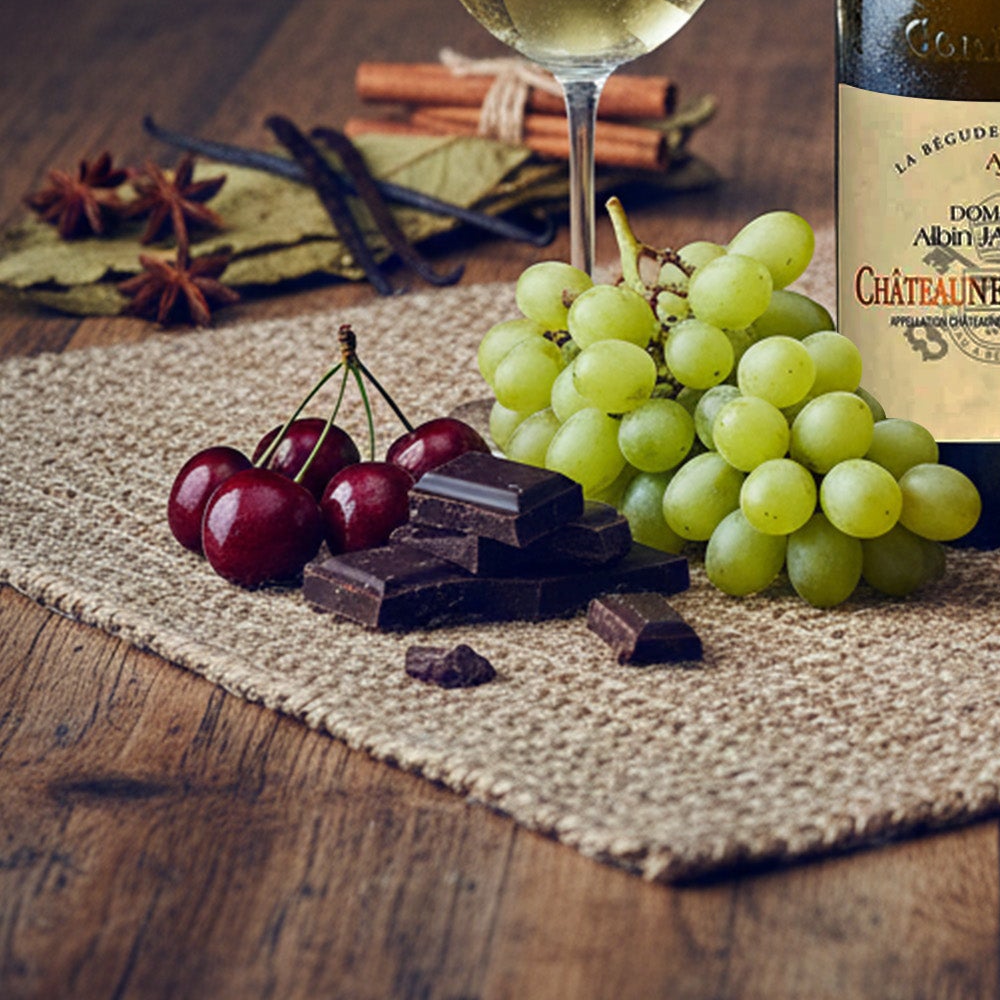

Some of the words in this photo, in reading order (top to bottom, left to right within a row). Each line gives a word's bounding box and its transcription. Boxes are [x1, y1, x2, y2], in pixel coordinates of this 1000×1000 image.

[895, 154, 917, 174] LA
[921, 126, 999, 156] BÉGUDE
[913, 225, 973, 247] Albin
[890, 315, 948, 328] APPELLATION
